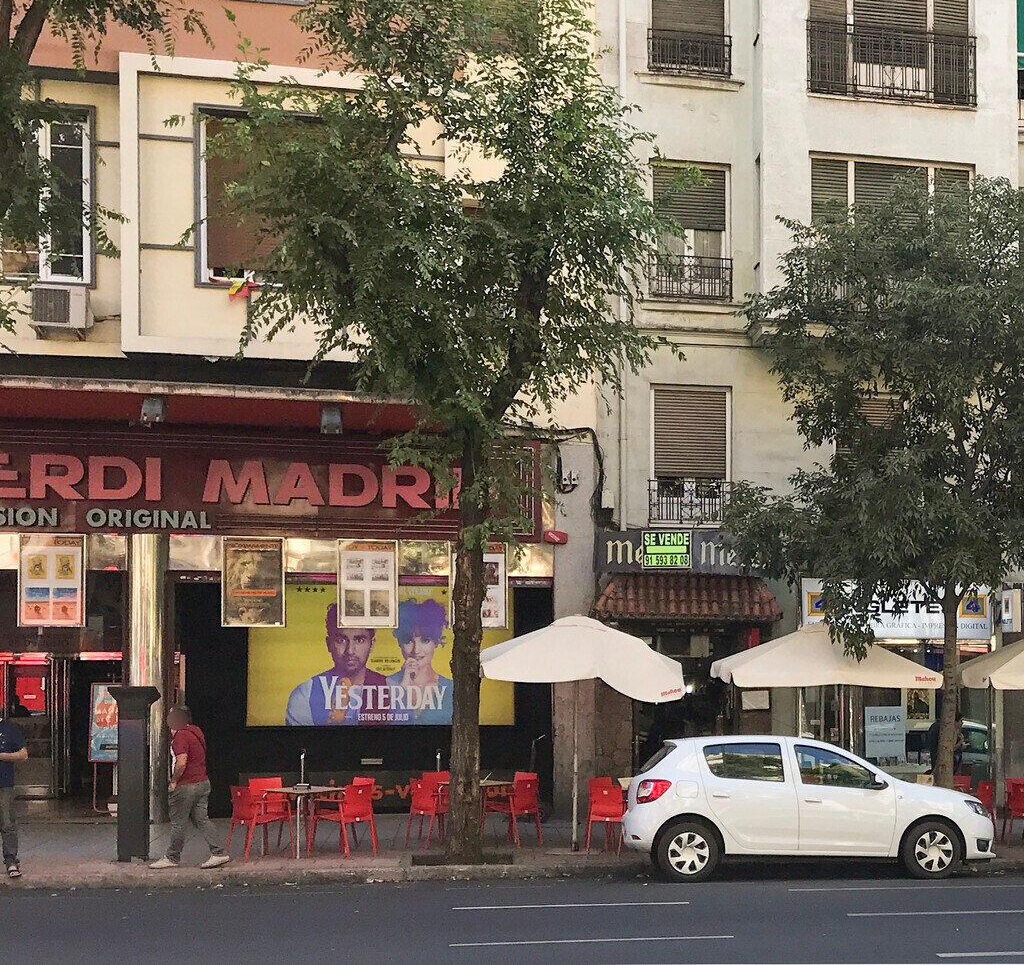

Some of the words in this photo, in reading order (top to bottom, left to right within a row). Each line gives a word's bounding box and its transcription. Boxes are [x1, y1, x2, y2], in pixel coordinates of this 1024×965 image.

[202, 459, 462, 509] MADRI
[86, 508, 211, 529] ORIGINAL
[644, 533, 656, 545] SE
[658, 533, 689, 545] VENDE
[645, 555, 653, 565] 91
[655, 555, 668, 565] 593
[669, 555, 679, 565] 82
[319, 675, 447, 710] YESTERDAY
[870, 715, 901, 723] REBAJAS
